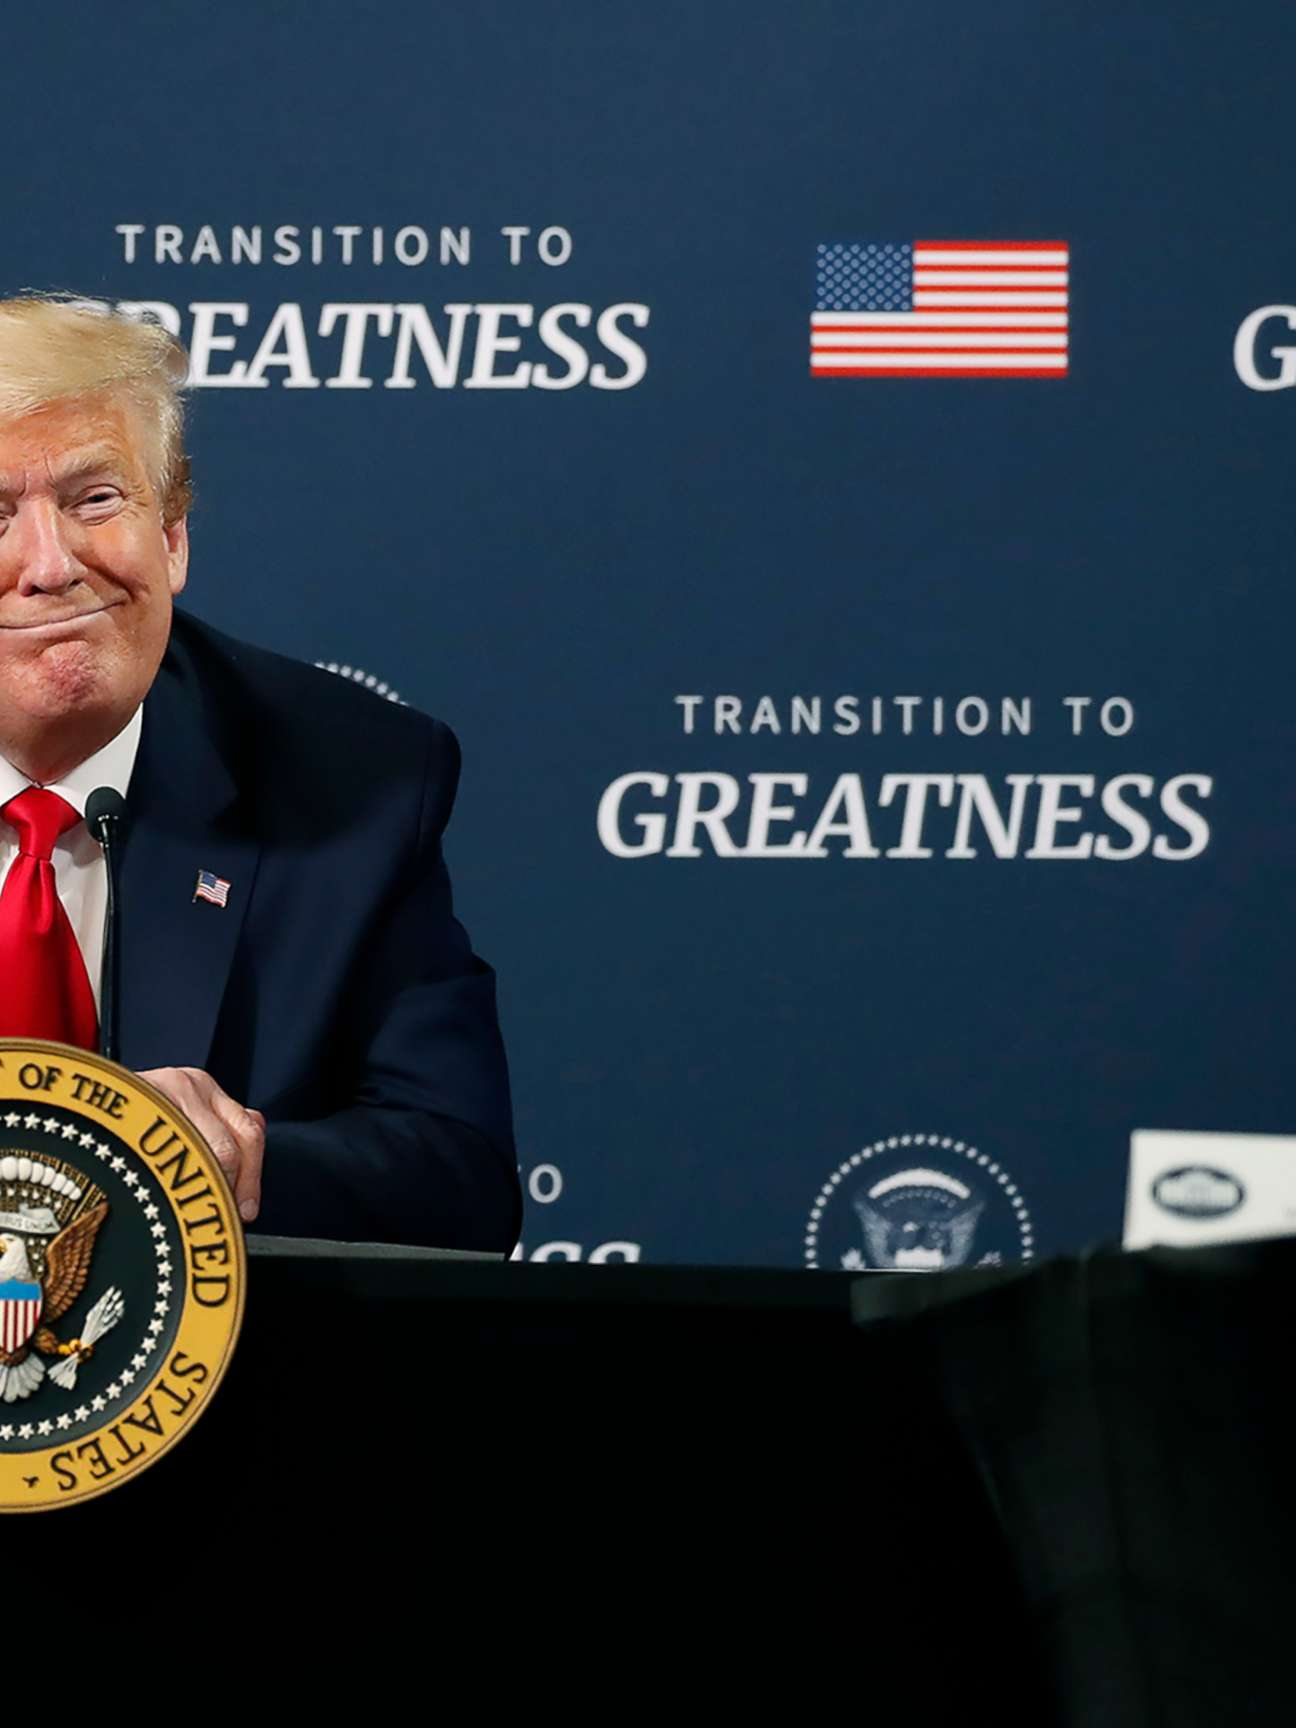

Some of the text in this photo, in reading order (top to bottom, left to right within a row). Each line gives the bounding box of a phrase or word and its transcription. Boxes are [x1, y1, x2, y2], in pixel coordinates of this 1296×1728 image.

[115, 224, 573, 267] TRANSITION TO
[64, 300, 651, 392] EATNESS
[675, 694, 1134, 737] TRANSITION TO
[596, 771, 1213, 861] GREATNESS
[18, 1062, 62, 1091] OF
[72, 1073, 129, 1120] THE
[138, 1114, 230, 1308] UNITED
[49, 1351, 209, 1492] STATES
